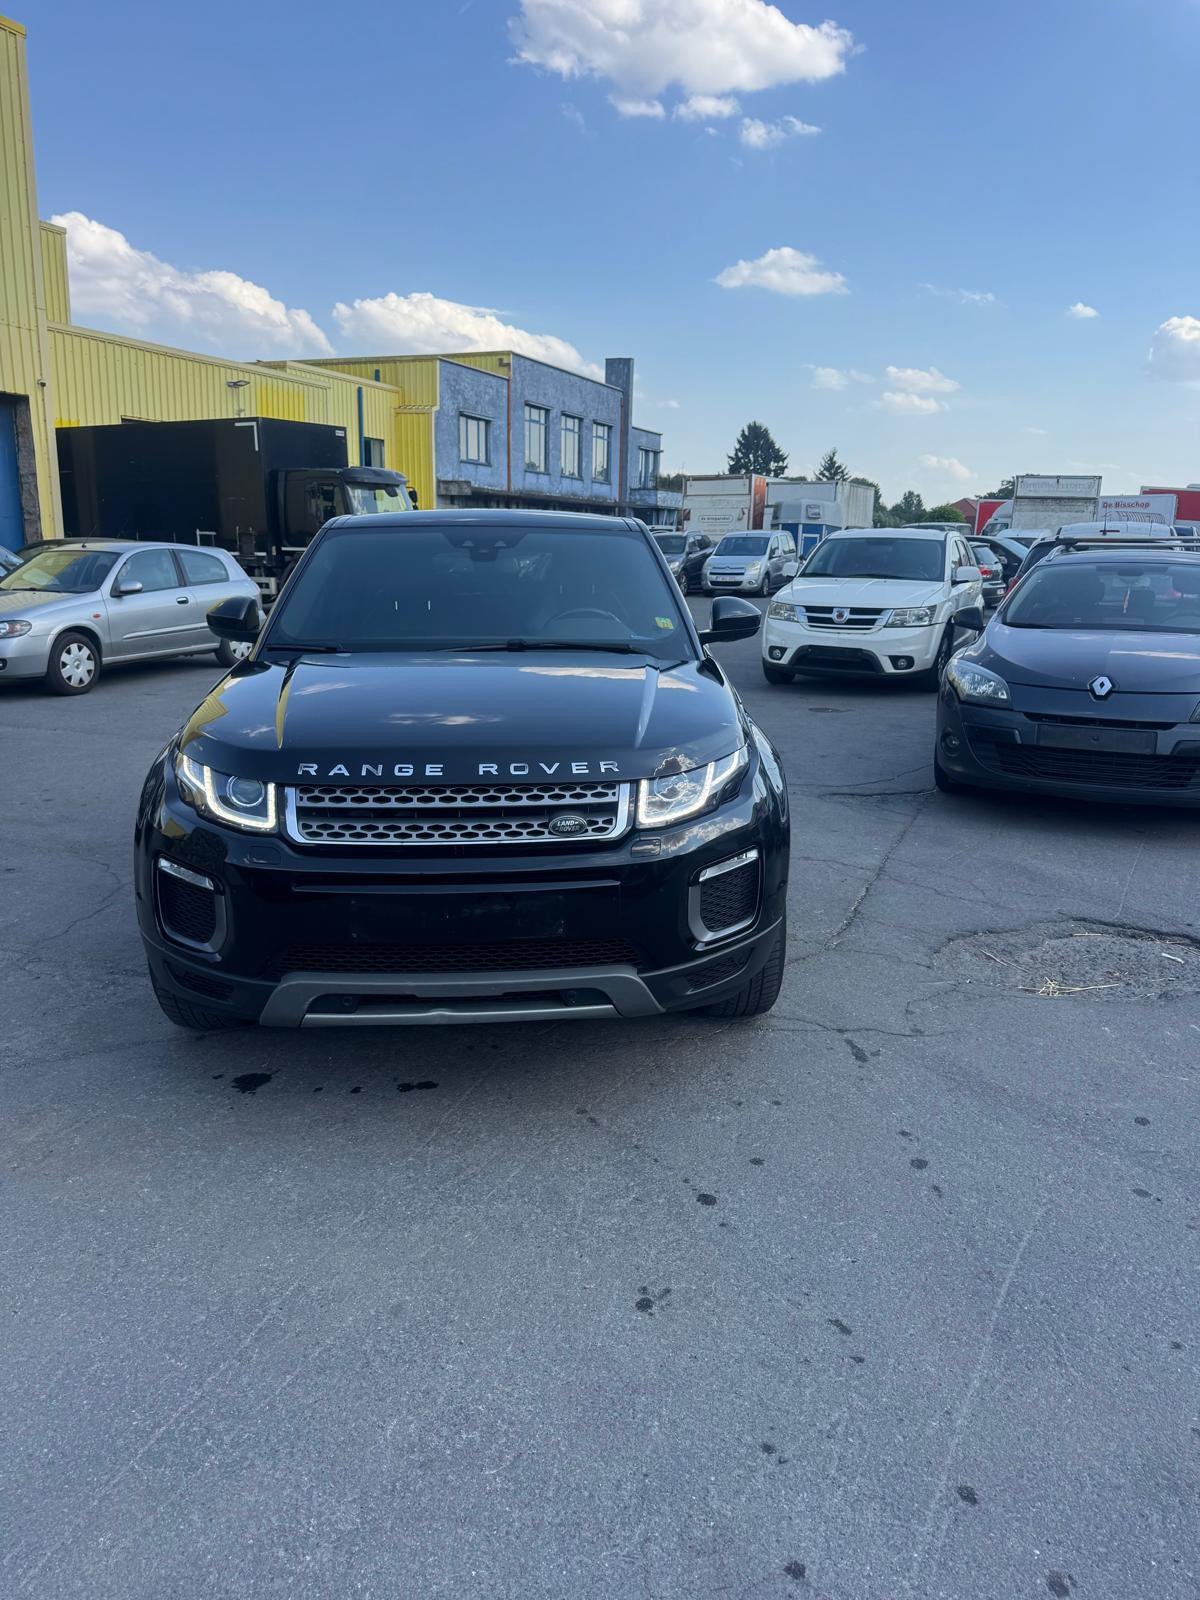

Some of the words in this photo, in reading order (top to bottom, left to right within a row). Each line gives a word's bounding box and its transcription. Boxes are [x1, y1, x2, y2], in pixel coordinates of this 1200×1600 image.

[1114, 501, 1150, 509] Bisschop
[297, 762, 444, 777] RANGE
[478, 760, 620, 776] ROVER
